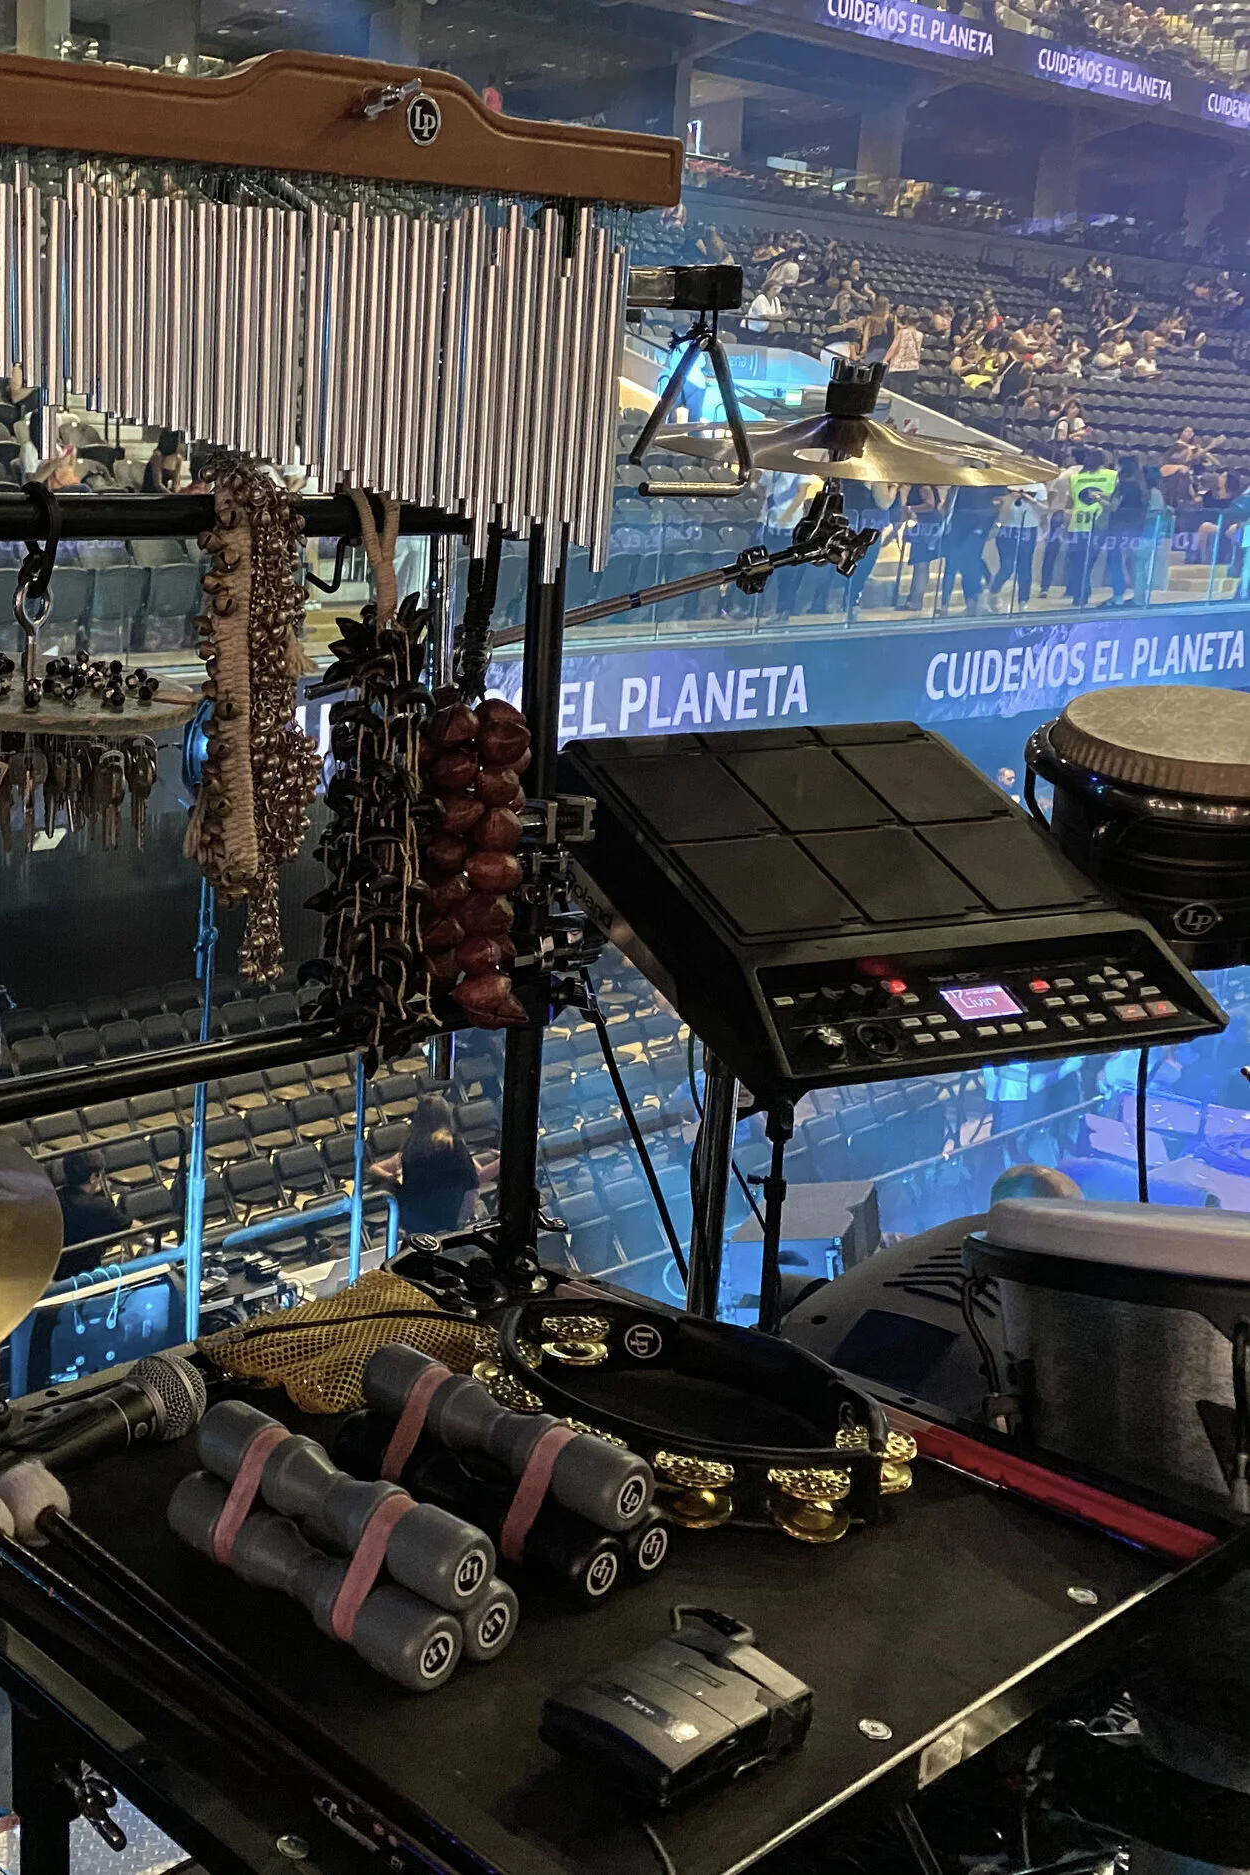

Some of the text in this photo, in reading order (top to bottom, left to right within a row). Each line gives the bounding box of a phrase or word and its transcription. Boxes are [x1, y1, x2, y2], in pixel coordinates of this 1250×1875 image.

[827, 0, 994, 56] CUIDEMOS EL PLANETA
[1038, 48, 1172, 101] CUIDEMOS EL PLANETA
[413, 105, 437, 138] LP
[925, 630, 1245, 700] CUIDEMOS EL PLANETA
[557, 664, 808, 738] EL PLANETA
[1182, 908, 1213, 931] LP
